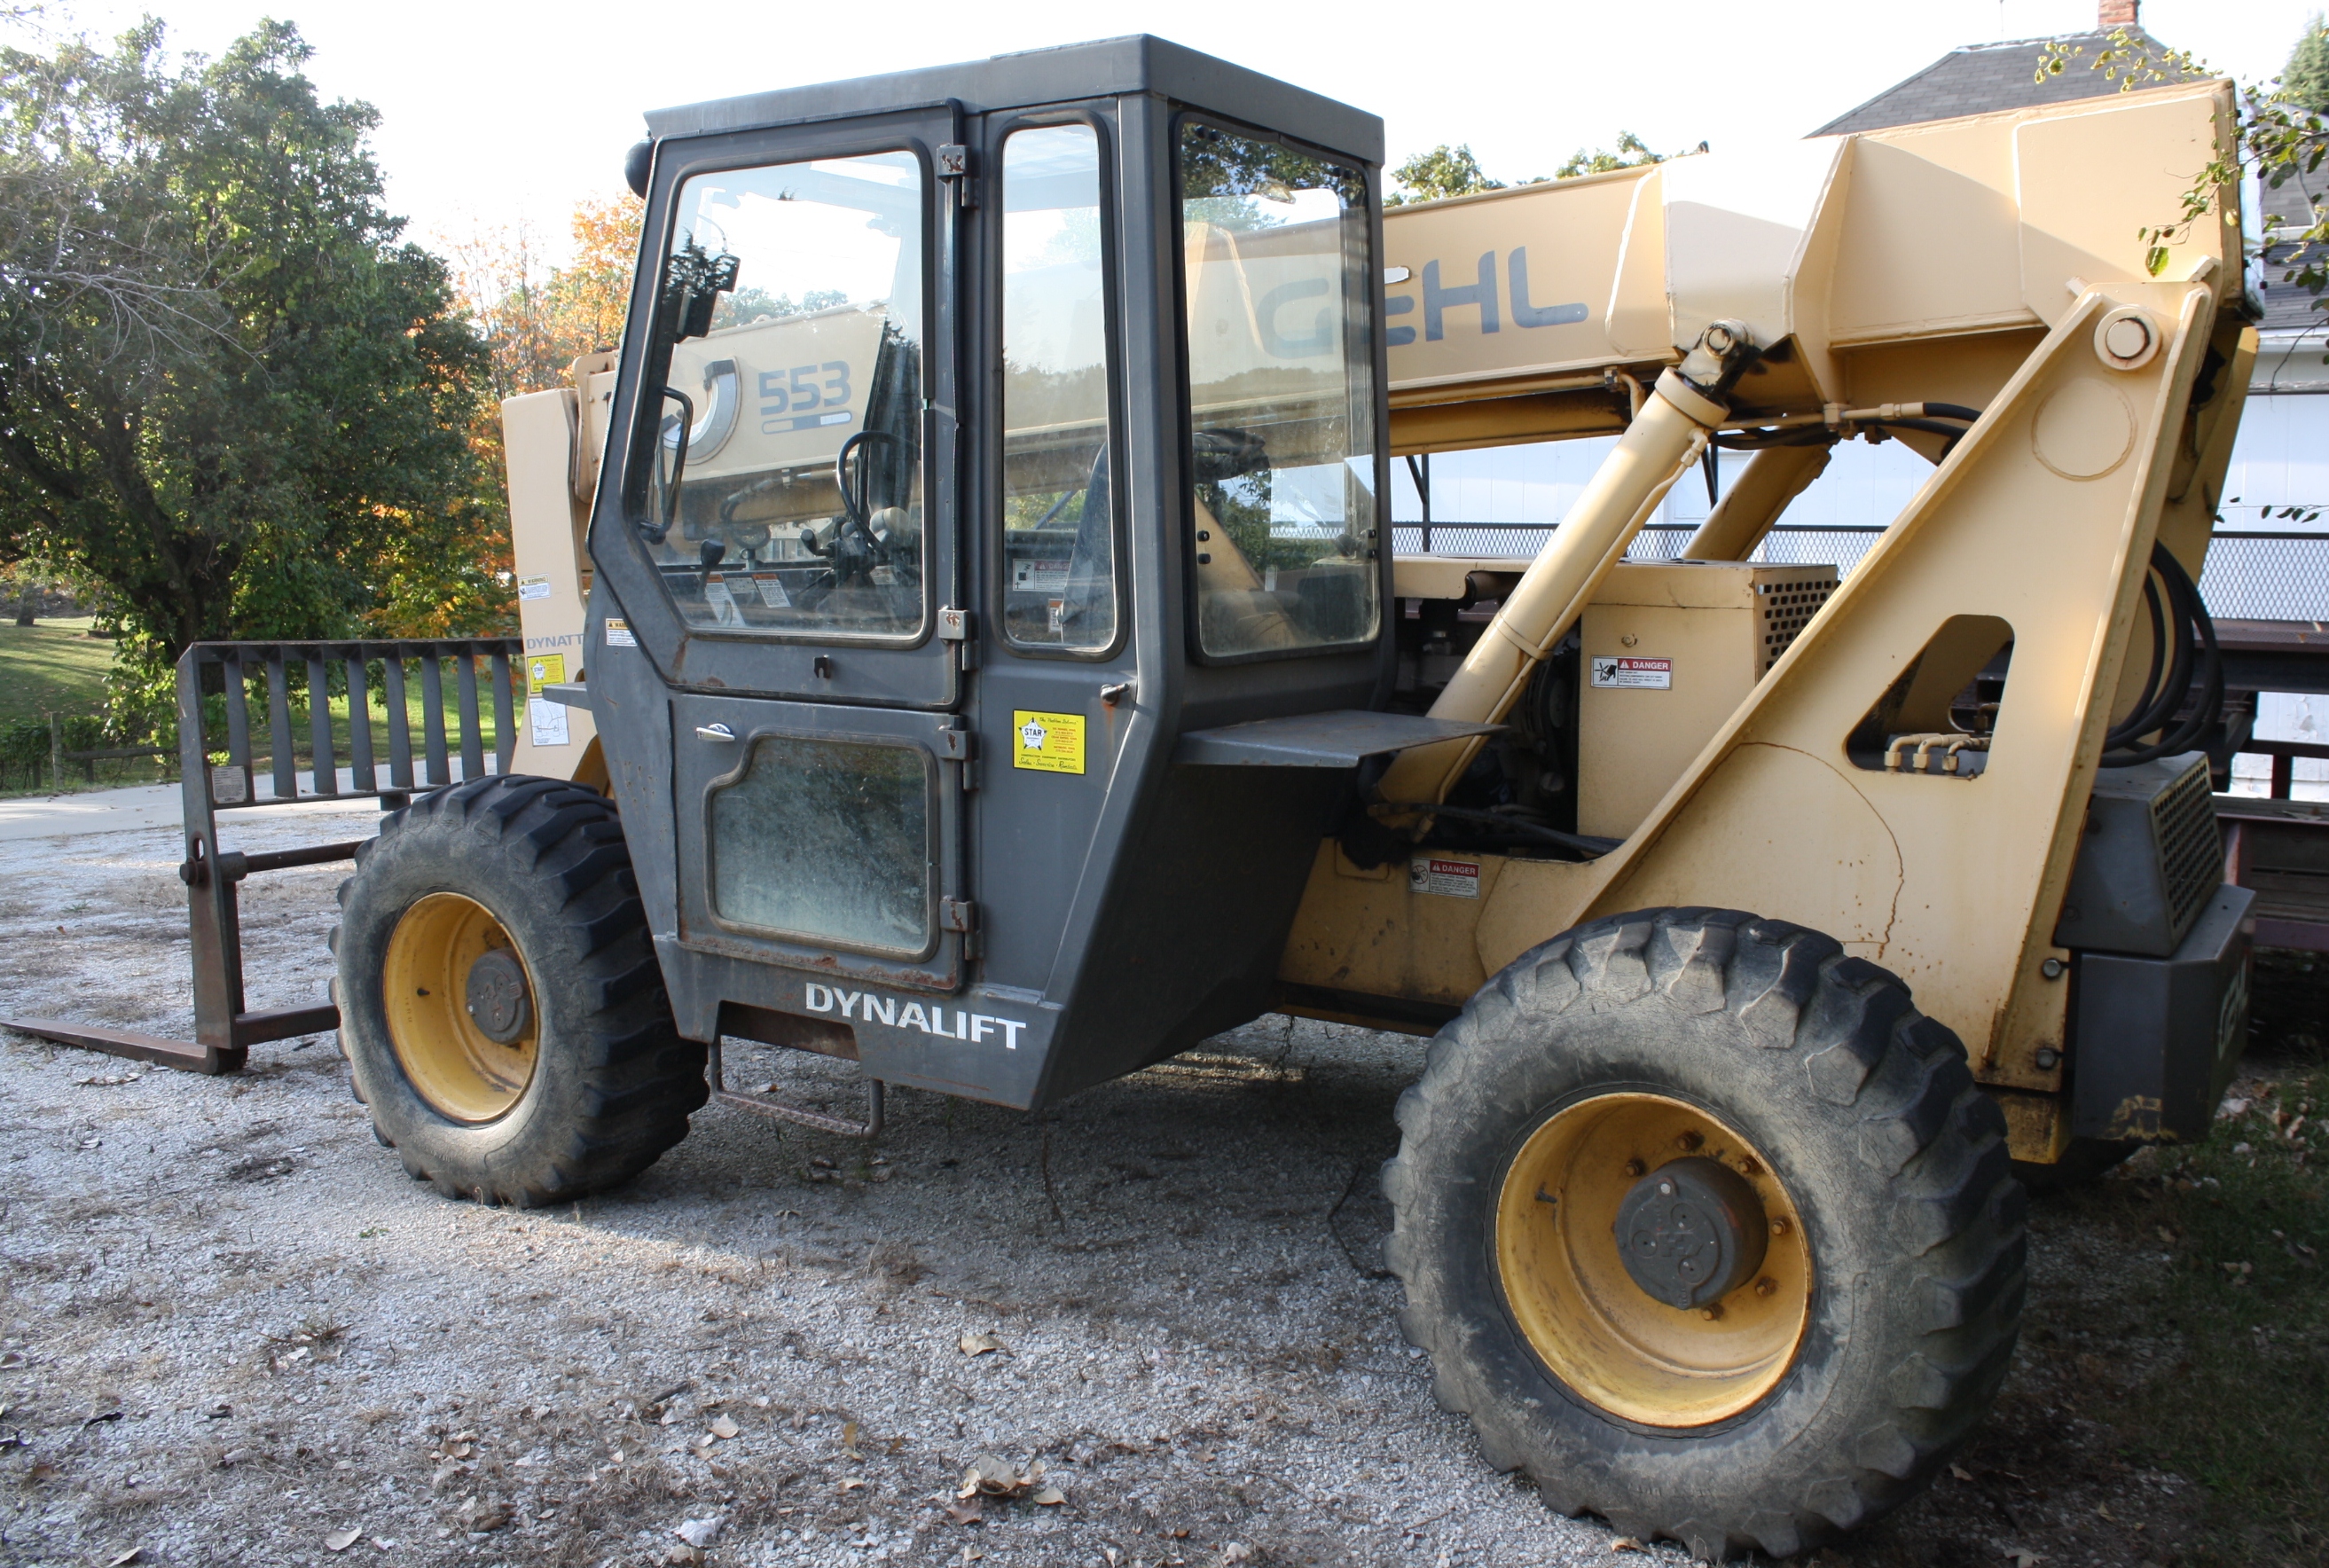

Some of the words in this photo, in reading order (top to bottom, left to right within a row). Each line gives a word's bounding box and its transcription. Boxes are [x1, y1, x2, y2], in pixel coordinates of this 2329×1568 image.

[758, 361, 851, 416] 553
[1024, 727, 1042, 736] STAR
[1442, 865, 1476, 874] DANGER
[805, 983, 1026, 1050] DYNALIFT
